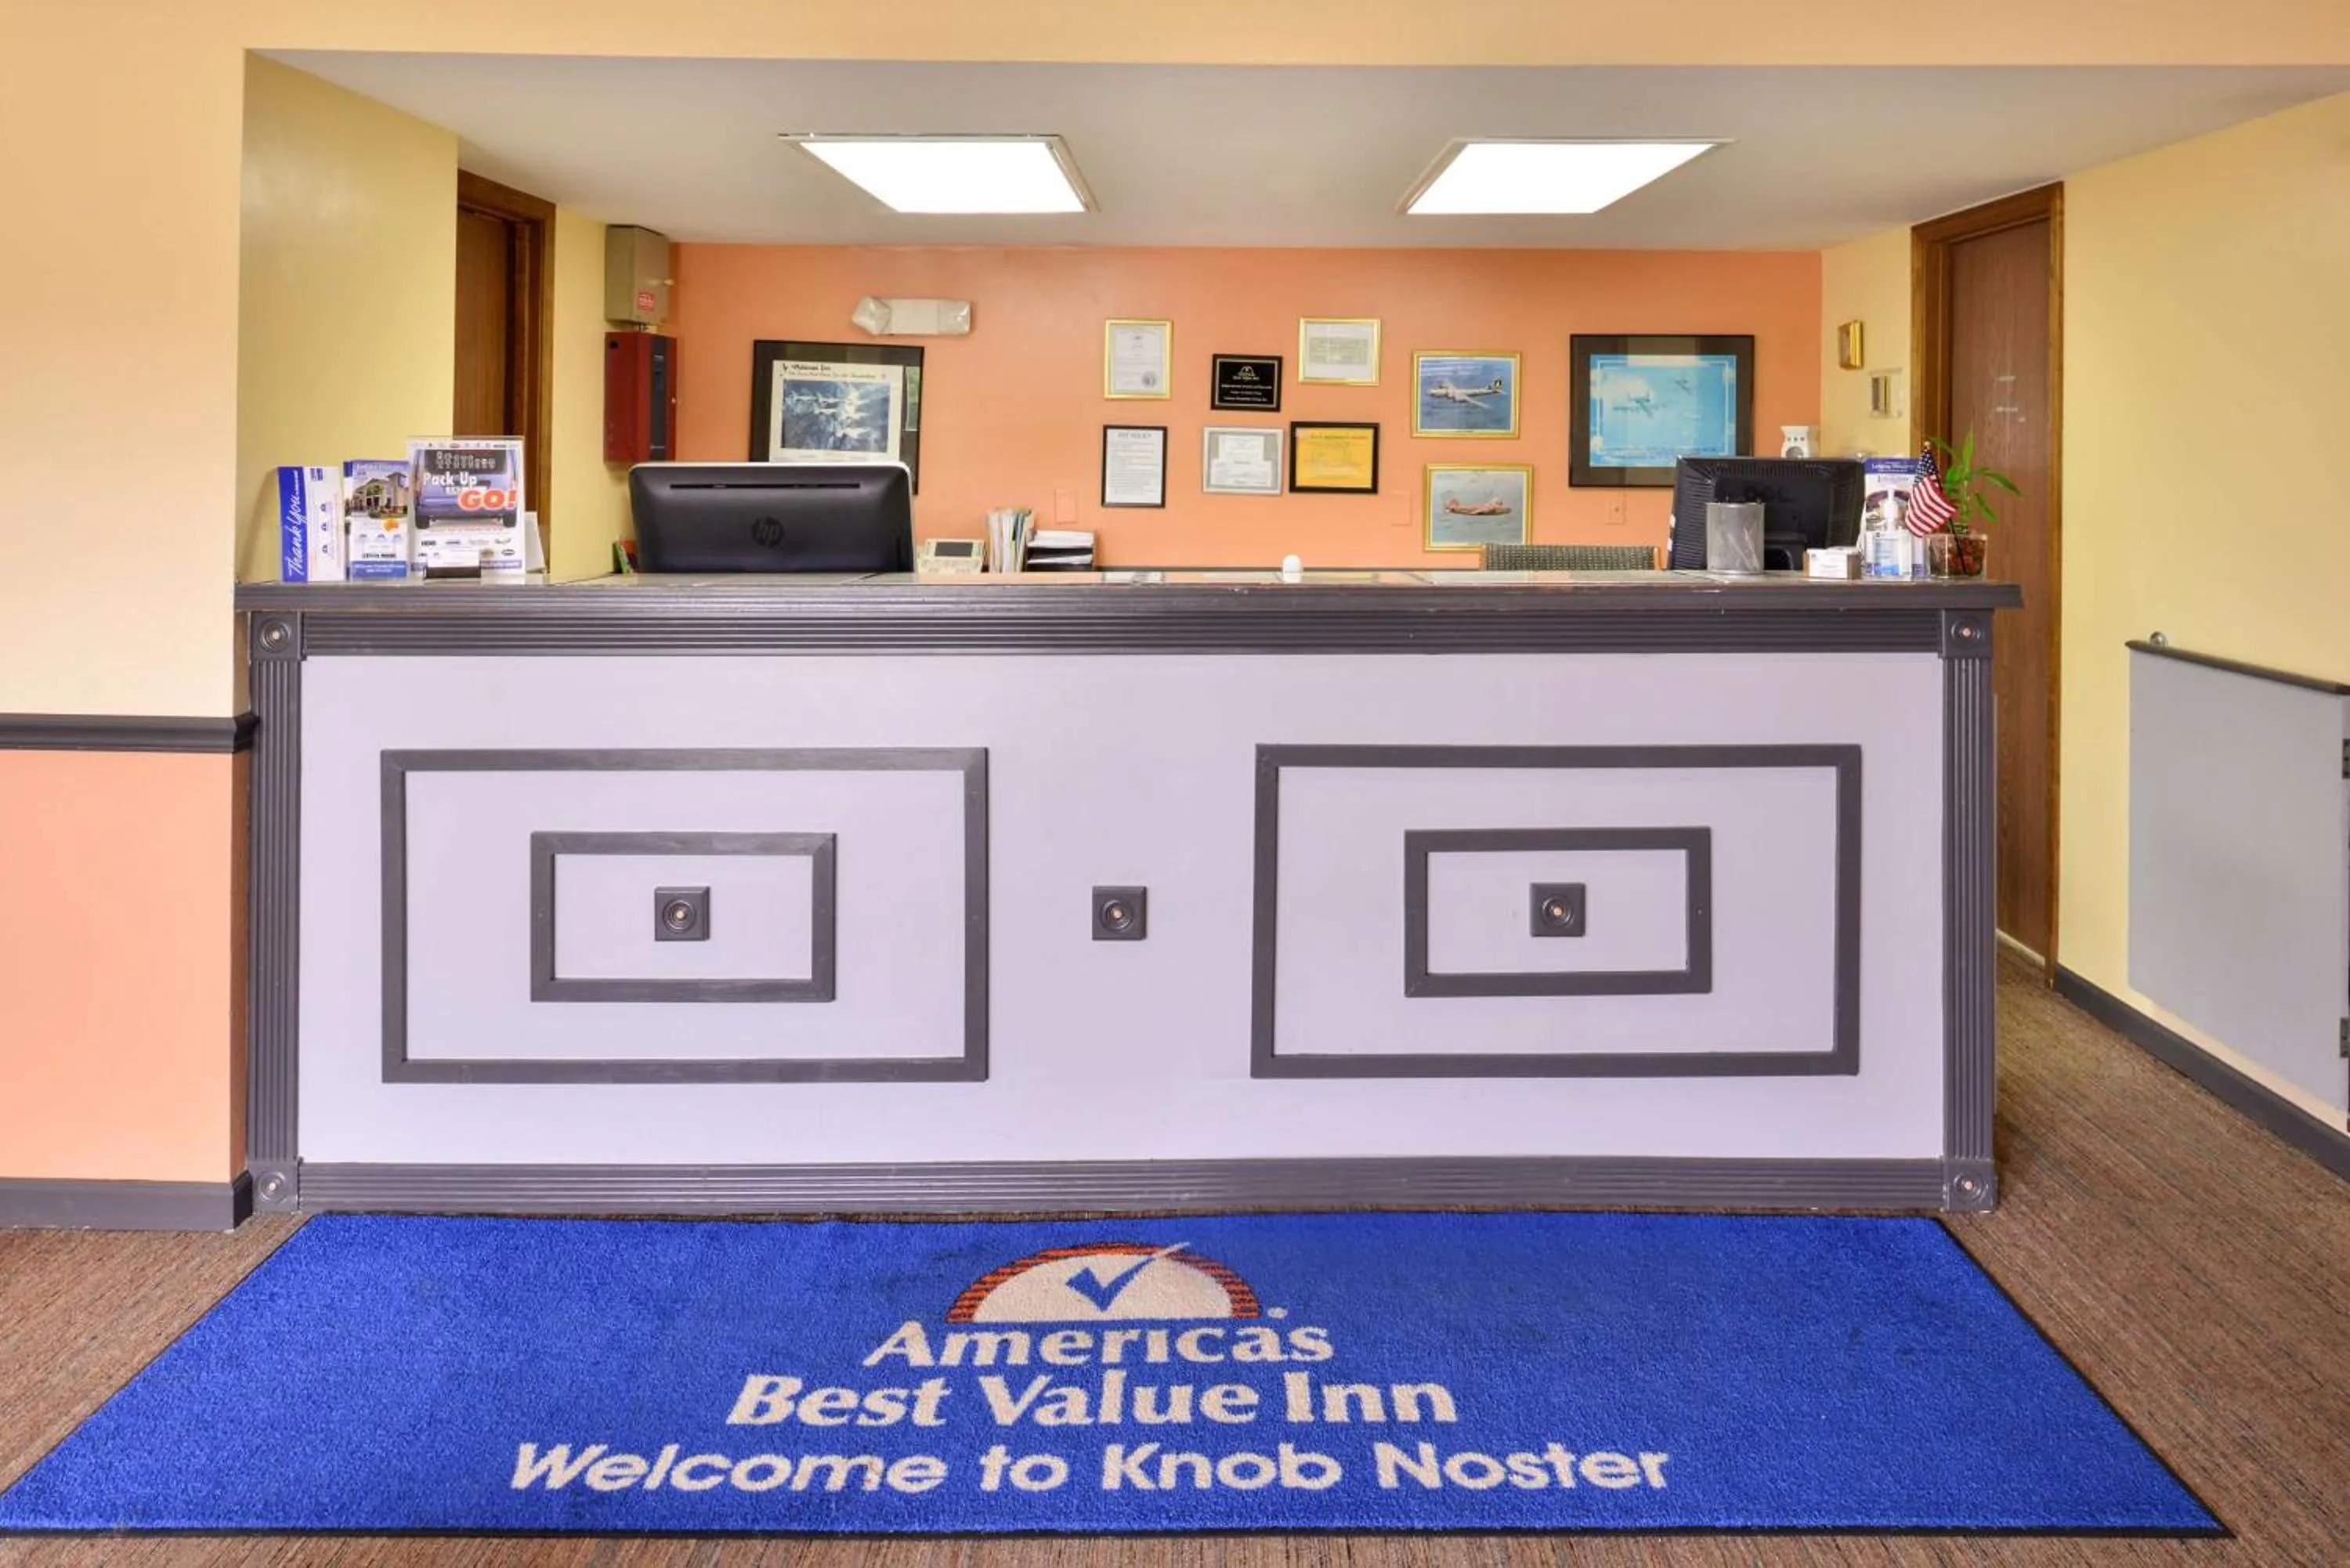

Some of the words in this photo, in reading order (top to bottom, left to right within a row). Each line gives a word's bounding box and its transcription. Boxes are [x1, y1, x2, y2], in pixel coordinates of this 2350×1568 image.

[423, 471, 454, 486] Pack
[459, 471, 477, 488] Up
[457, 488, 518, 511] GO!
[284, 526, 305, 577] Thank
[862, 1321, 1333, 1367] Americas
[726, 1375, 950, 1426] Best
[978, 1369, 1259, 1426] Value
[1284, 1371, 1458, 1423] Inn
[511, 1443, 947, 1494] Welcome
[978, 1444, 1068, 1492] to
[1102, 1443, 1342, 1490] Knob
[1374, 1443, 1669, 1490] Noster
